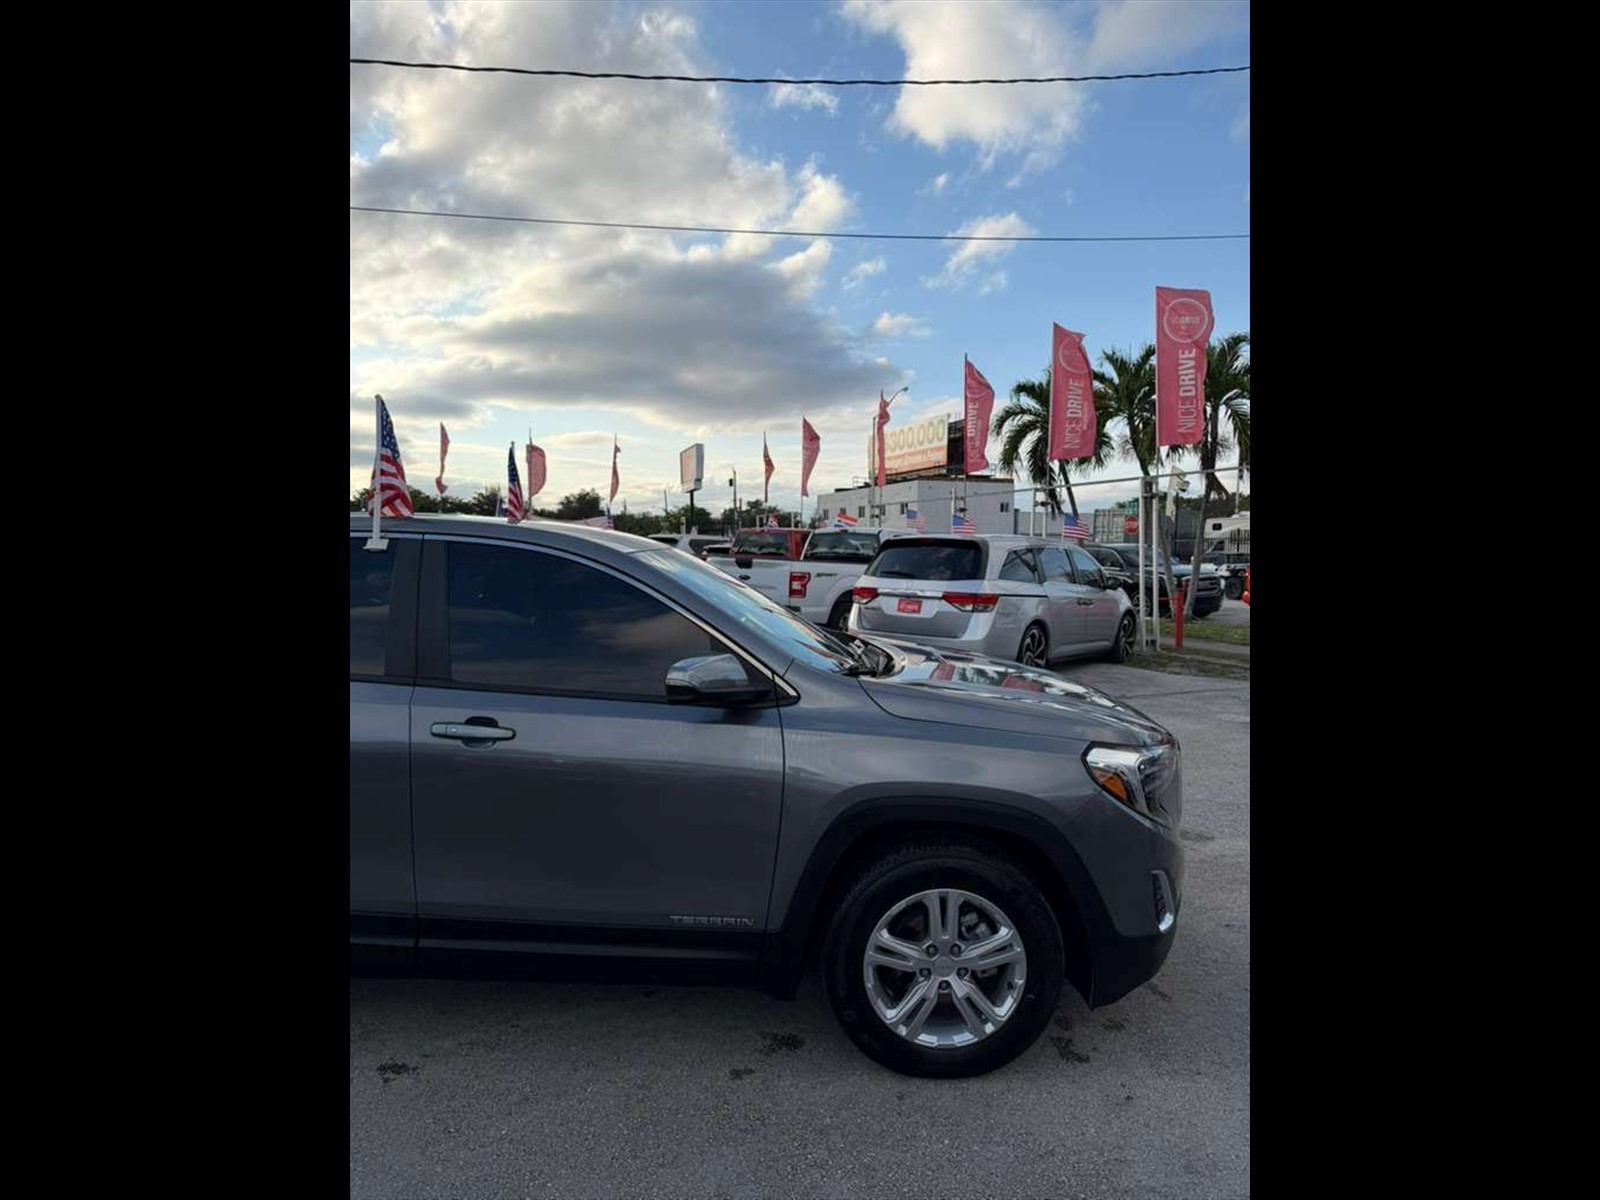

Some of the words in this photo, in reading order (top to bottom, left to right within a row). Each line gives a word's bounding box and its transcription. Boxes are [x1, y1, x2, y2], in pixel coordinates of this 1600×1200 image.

[1178, 348, 1196, 397] DRIVE
[1067, 378, 1084, 420] DRIVE
[1178, 399, 1196, 433] NICE
[669, 915, 754, 927] TERRAIN
